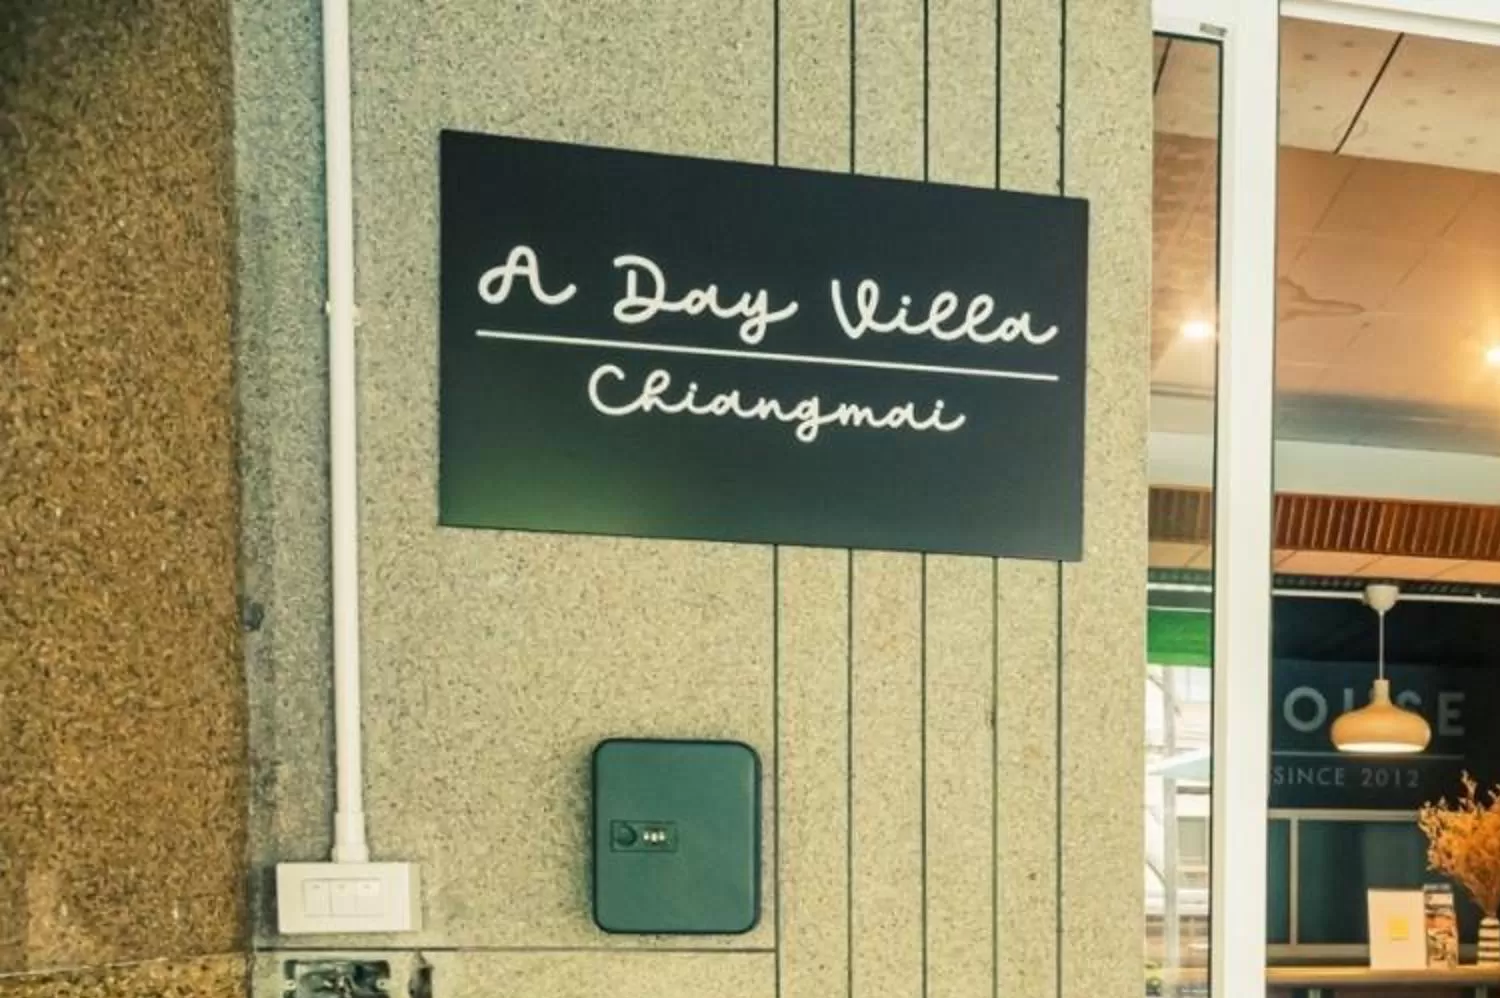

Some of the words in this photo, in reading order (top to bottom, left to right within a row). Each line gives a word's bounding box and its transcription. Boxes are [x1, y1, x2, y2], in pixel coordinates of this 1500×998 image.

[477, 245, 577, 304] A
[612, 255, 799, 344] Day
[831, 278, 1059, 344] Villa
[588, 364, 966, 442] Chiangmai
[1283, 686, 1465, 736] OE
[1273, 766, 1346, 786] SINCE
[1361, 768, 1420, 788] 2012
